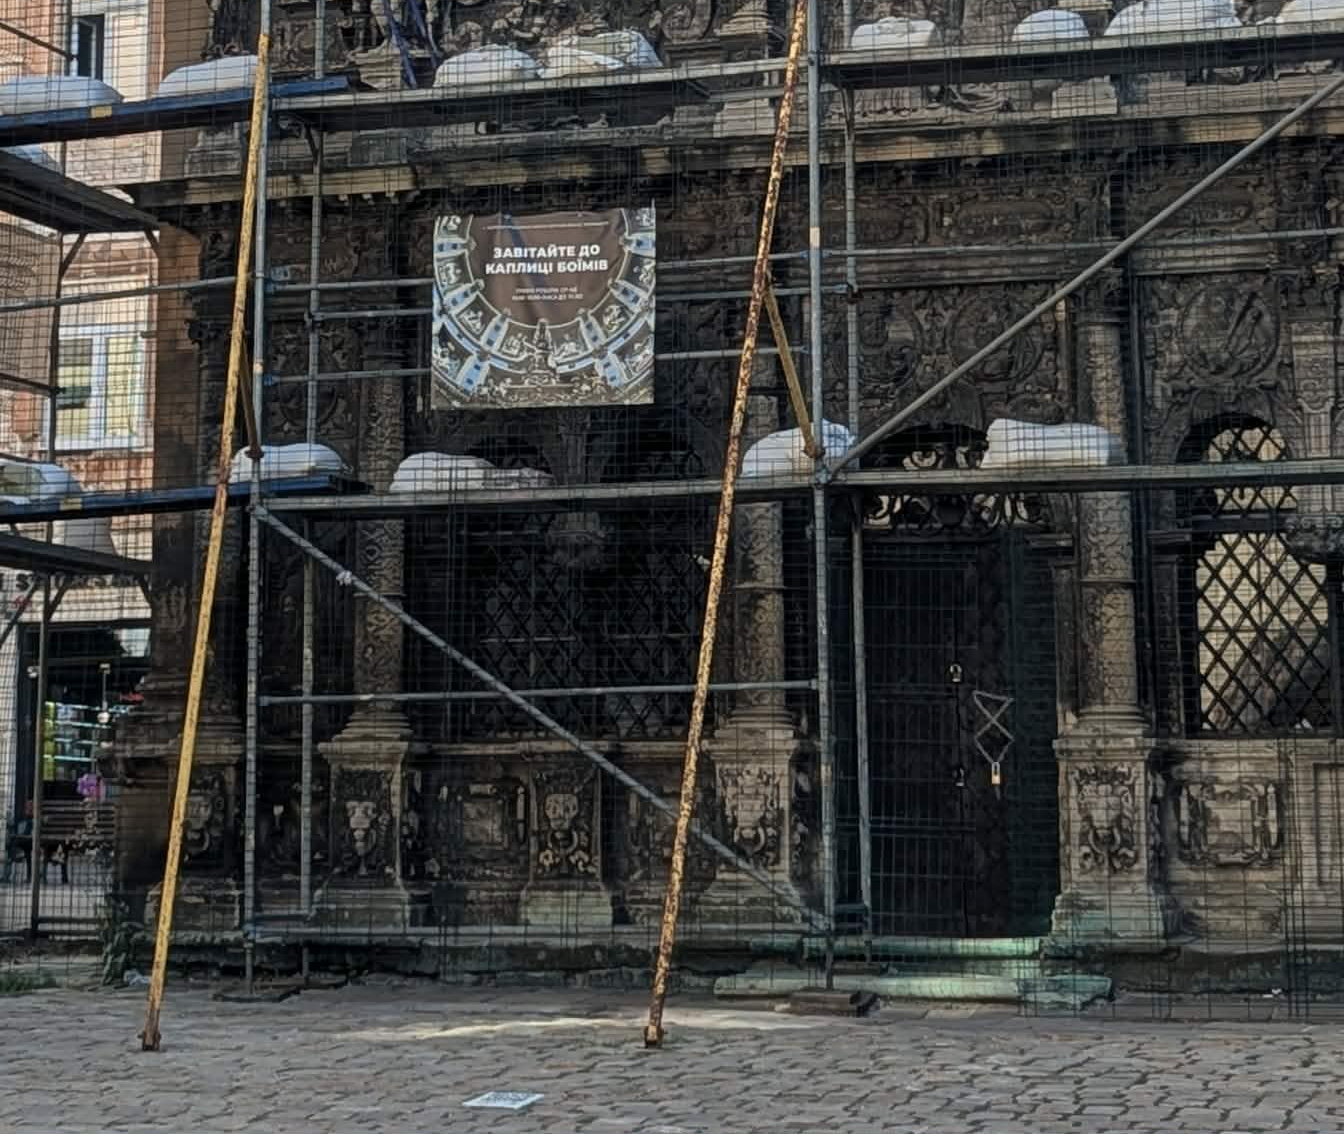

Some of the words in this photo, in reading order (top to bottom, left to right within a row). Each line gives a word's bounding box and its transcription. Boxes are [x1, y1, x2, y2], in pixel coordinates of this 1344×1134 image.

[493, 244, 576, 258] ЗАВІТАЙТЕ
[578, 244, 601, 258] ДО
[485, 262, 553, 275] КАПЛИЦІ
[557, 258, 609, 273] БОЇМІВ
